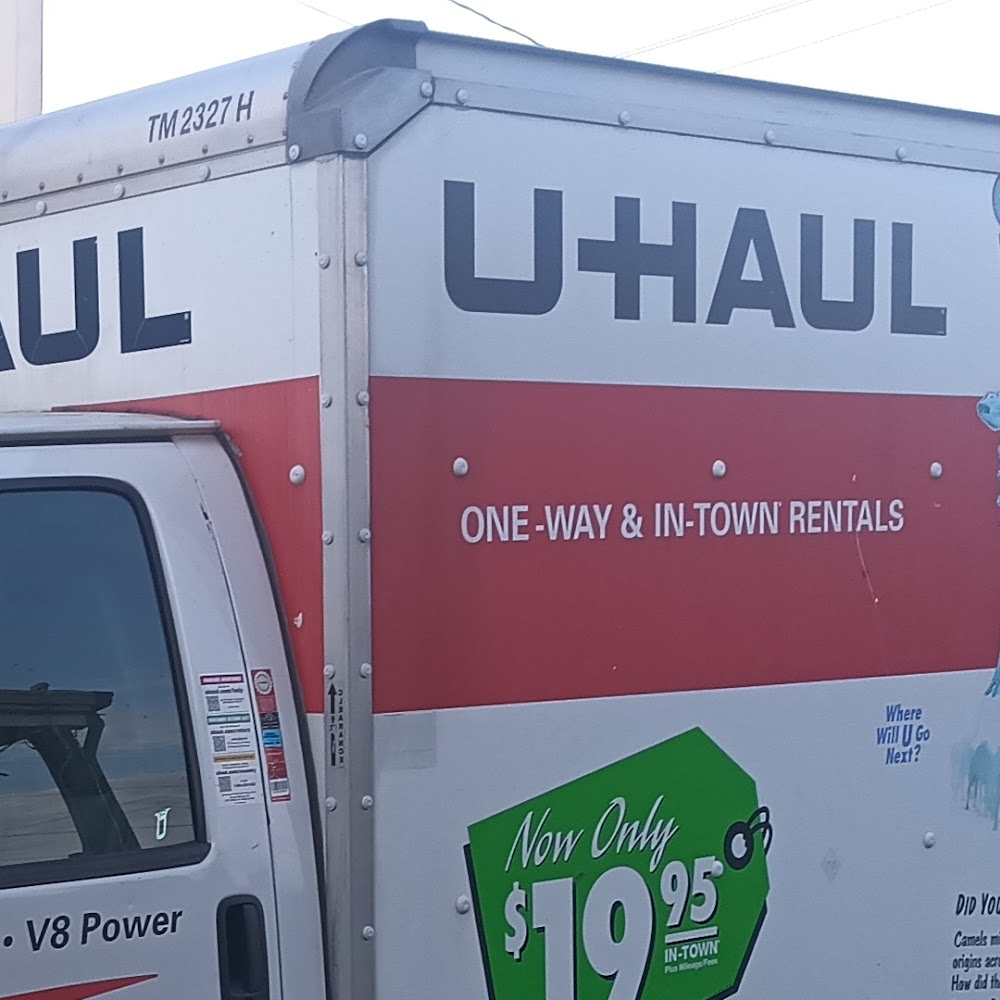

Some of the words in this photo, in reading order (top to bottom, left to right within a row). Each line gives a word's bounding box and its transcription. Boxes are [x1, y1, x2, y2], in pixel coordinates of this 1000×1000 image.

[148, 109, 179, 143] TM
[180, 95, 232, 135] 2327
[236, 90, 255, 122] H
[444, 180, 947, 336] U-HAUL
[620, 503, 644, 540] &
[655, 500, 782, 538] IN-TOWN
[789, 498, 905, 535] RENTALS
[886, 703, 922, 722] Where
[876, 725, 900, 745] Will
[902, 724, 913, 747] U
[916, 725, 930, 742] Go
[885, 744, 921, 765] Next?
[505, 807, 584, 872] Now
[591, 795, 680, 873] Only
[27, 914, 71, 952] V8
[81, 910, 183, 945] Power
[954, 930, 987, 948] Camels
[665, 940, 720, 963] IN-TOWN
[952, 953, 982, 973] origins
[951, 974, 971, 991] How
[974, 973, 988, 990] did
